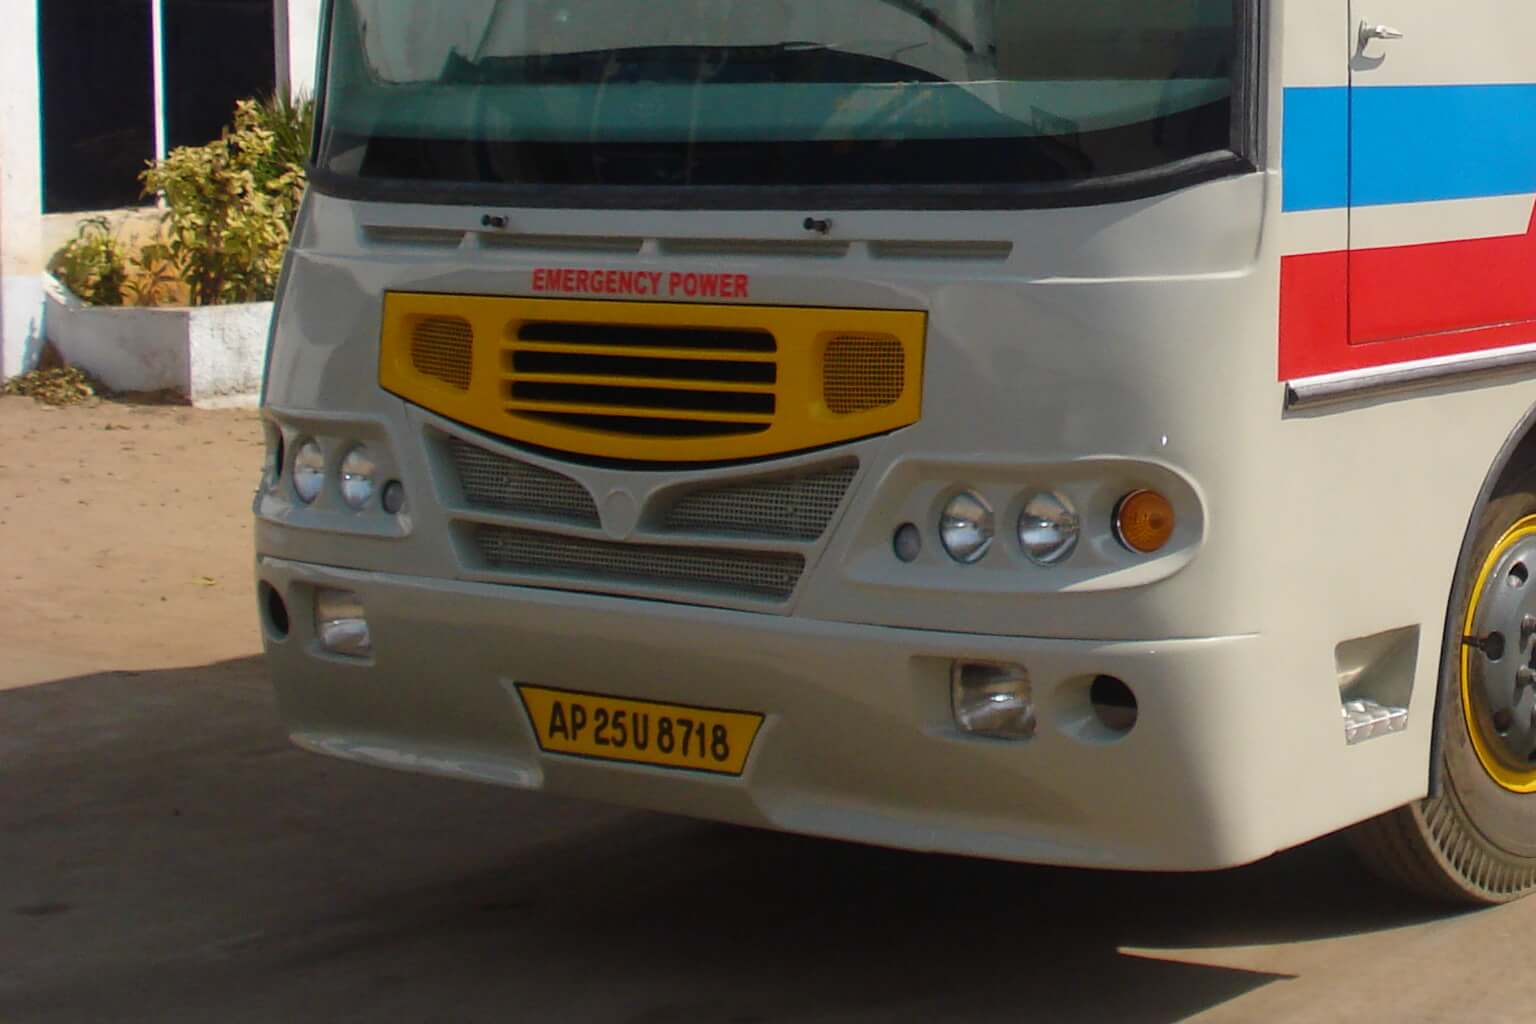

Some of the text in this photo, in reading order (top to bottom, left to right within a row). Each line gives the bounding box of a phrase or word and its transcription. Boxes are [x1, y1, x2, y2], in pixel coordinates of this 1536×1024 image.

[531, 268, 749, 298] EMERGENCY POWER
[549, 700, 587, 741] AP
[656, 716, 730, 762] 8718
